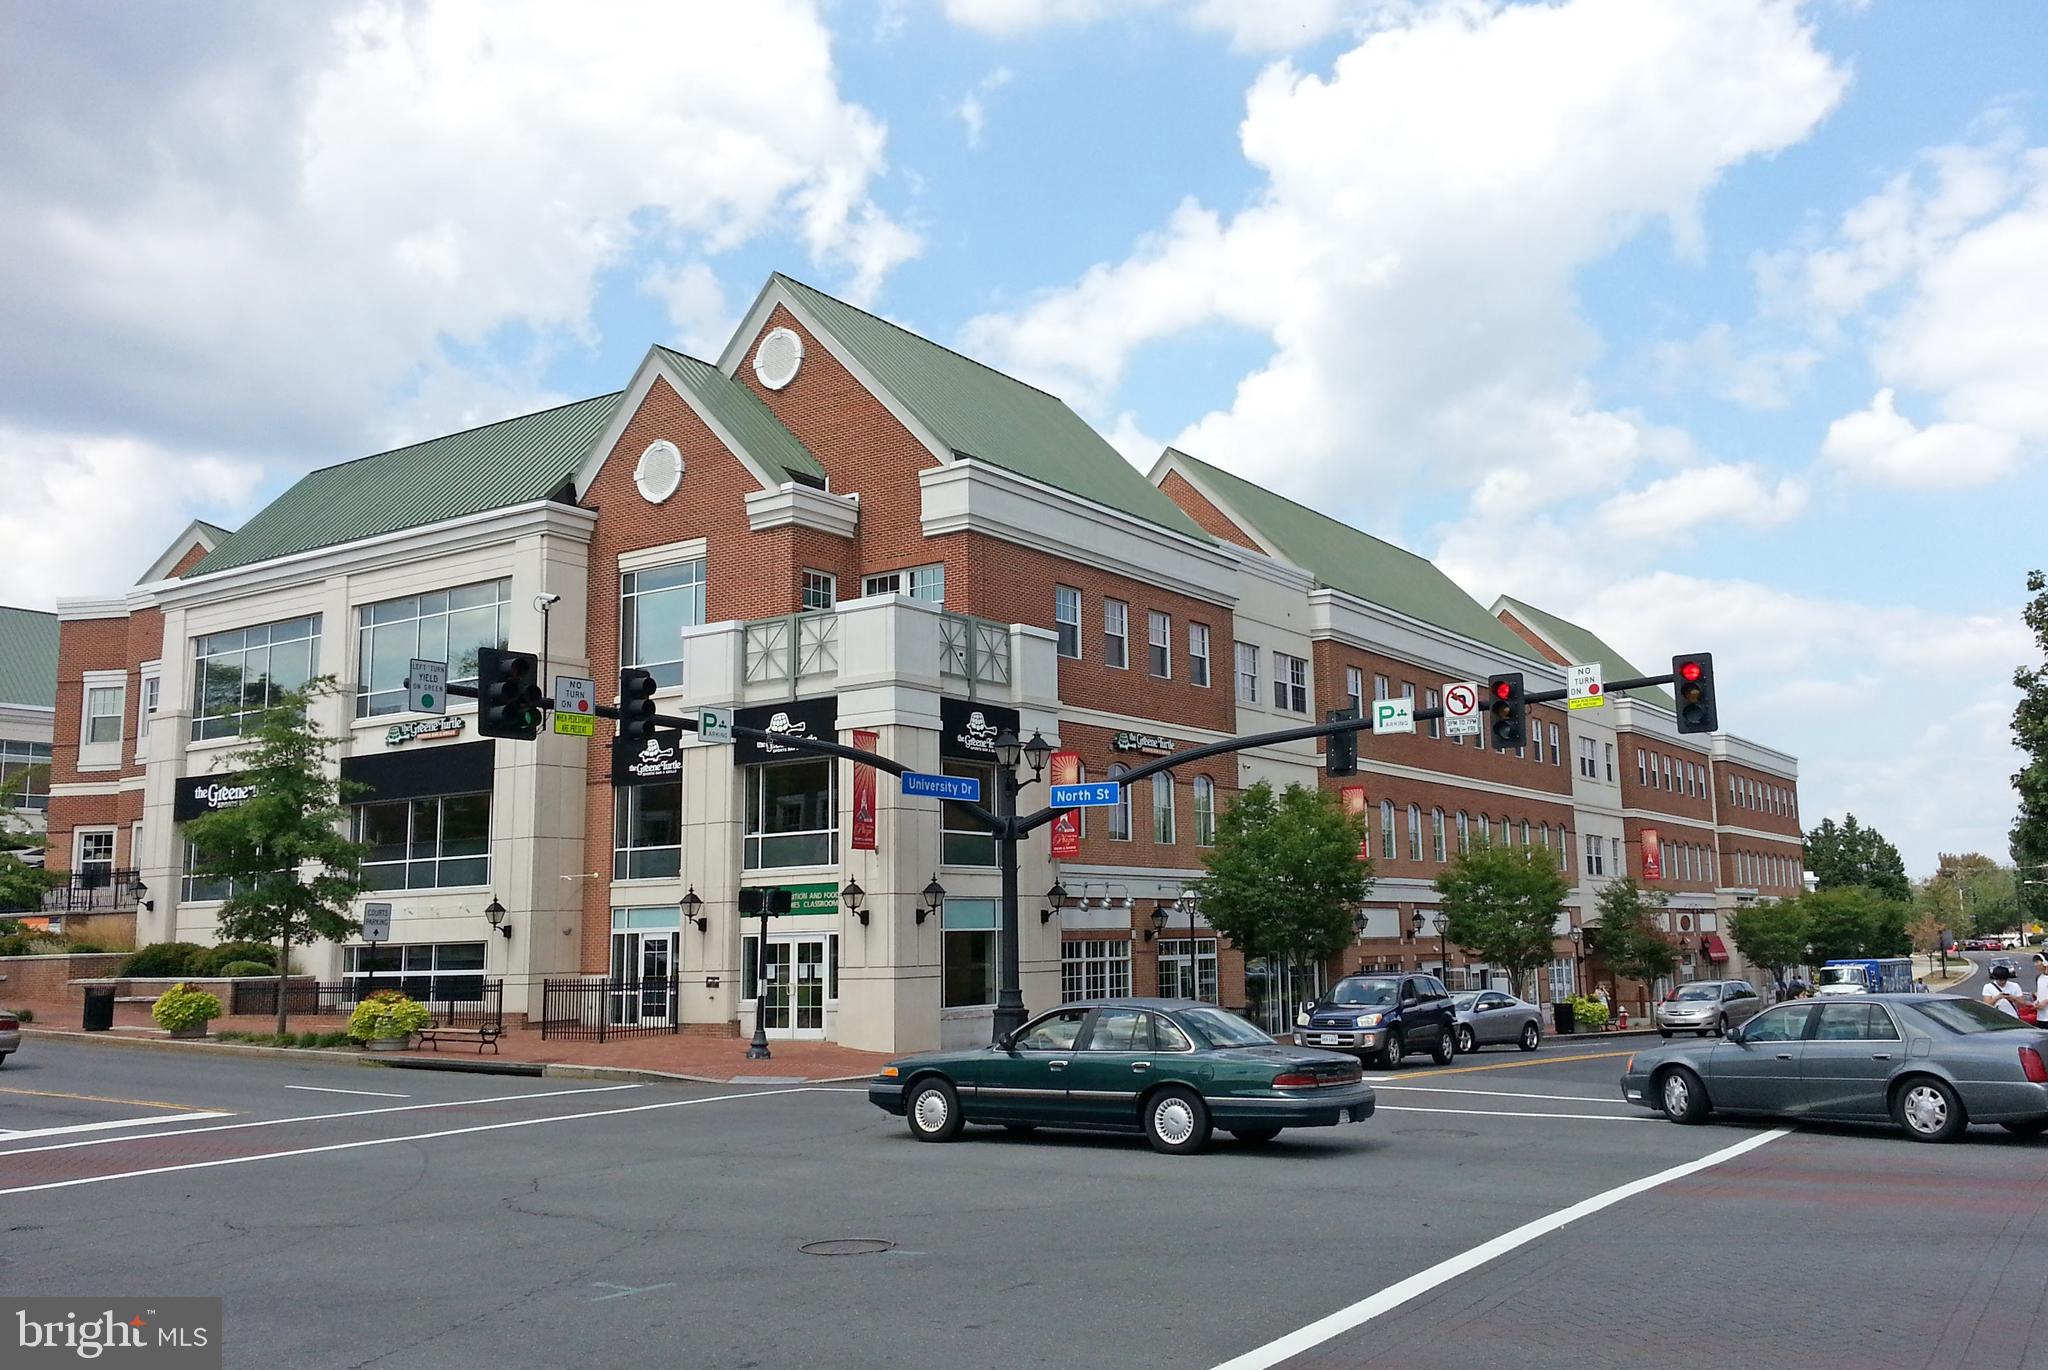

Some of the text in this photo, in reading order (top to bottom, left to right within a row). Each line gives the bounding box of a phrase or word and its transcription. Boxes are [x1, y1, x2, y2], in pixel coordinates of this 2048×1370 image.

[413, 662, 445, 673] LEFT TURN
[1578, 667, 1591, 675] NO
[419, 673, 439, 683] YIELD
[1574, 676, 1595, 685] TURN
[424, 684, 444, 693] GREEN
[569, 681, 582, 689] NO
[565, 690, 585, 699] TURN
[1570, 688, 1582, 696] ON
[561, 700, 572, 709] ON
[410, 721, 439, 737] Greene
[439, 716, 463, 731] Turtle
[964, 734, 987, 749] Greene
[1136, 733, 1158, 749] Greene
[1157, 736, 1175, 751] Turtle
[637, 763, 662, 776] Greene
[661, 760, 682, 771] Turtle
[908, 777, 973, 797] University Dr
[194, 785, 208, 799] the
[208, 783, 249, 807] Greene
[1056, 788, 1110, 803] North St
[809, 892, 822, 900] AND
[368, 909, 389, 917] COURTS
[365, 918, 389, 927] PARKING
